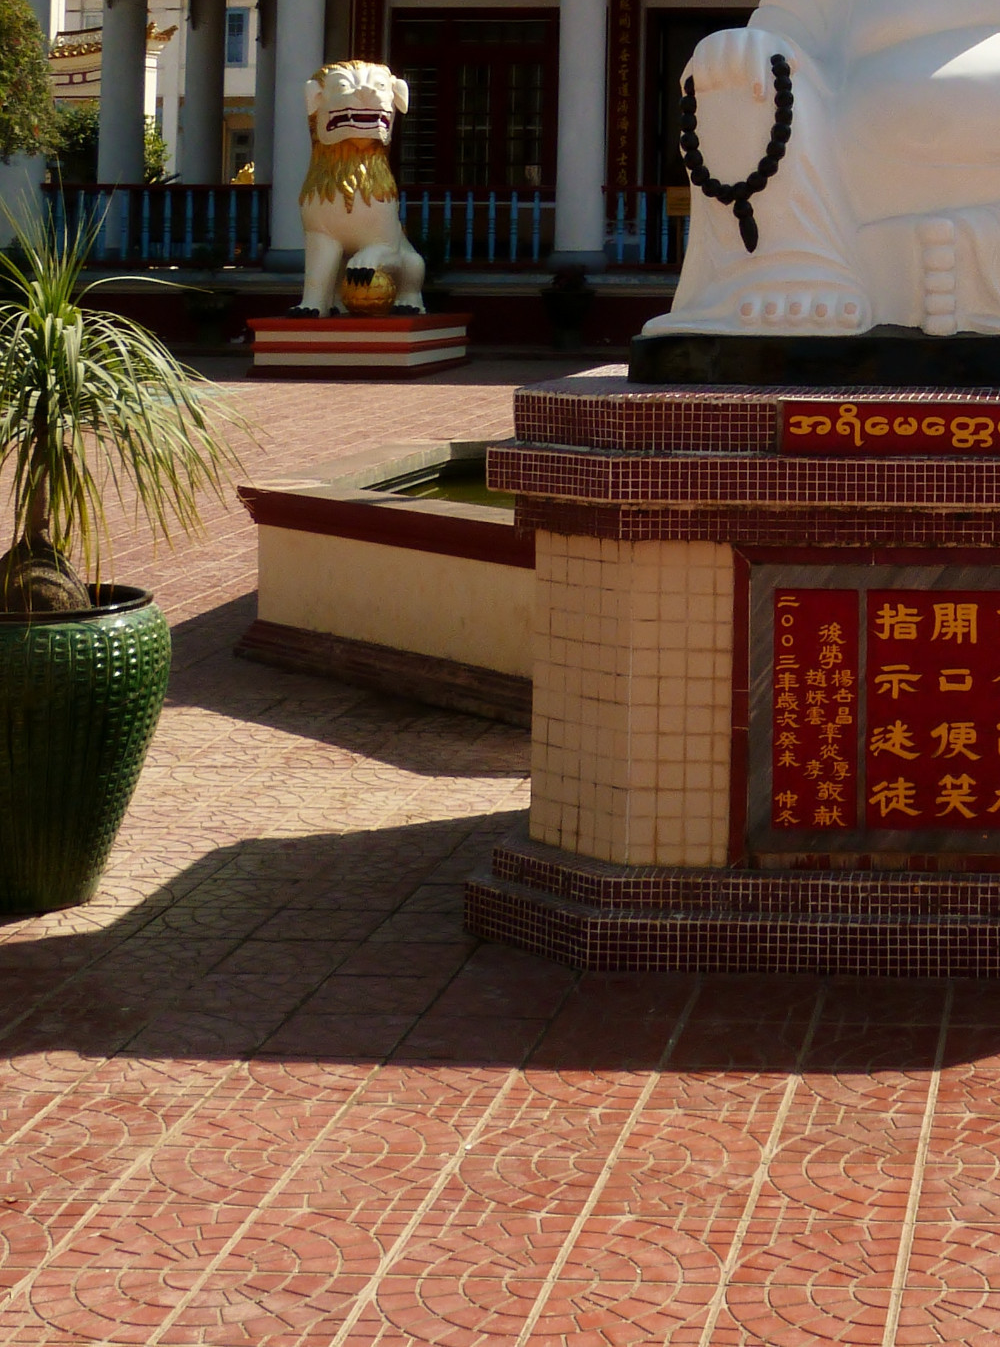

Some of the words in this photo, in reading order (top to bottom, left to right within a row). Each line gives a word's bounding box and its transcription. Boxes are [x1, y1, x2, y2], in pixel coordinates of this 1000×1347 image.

[868, 603, 923, 817] 指示迷徒
[930, 602, 981, 819] 開口便笑
